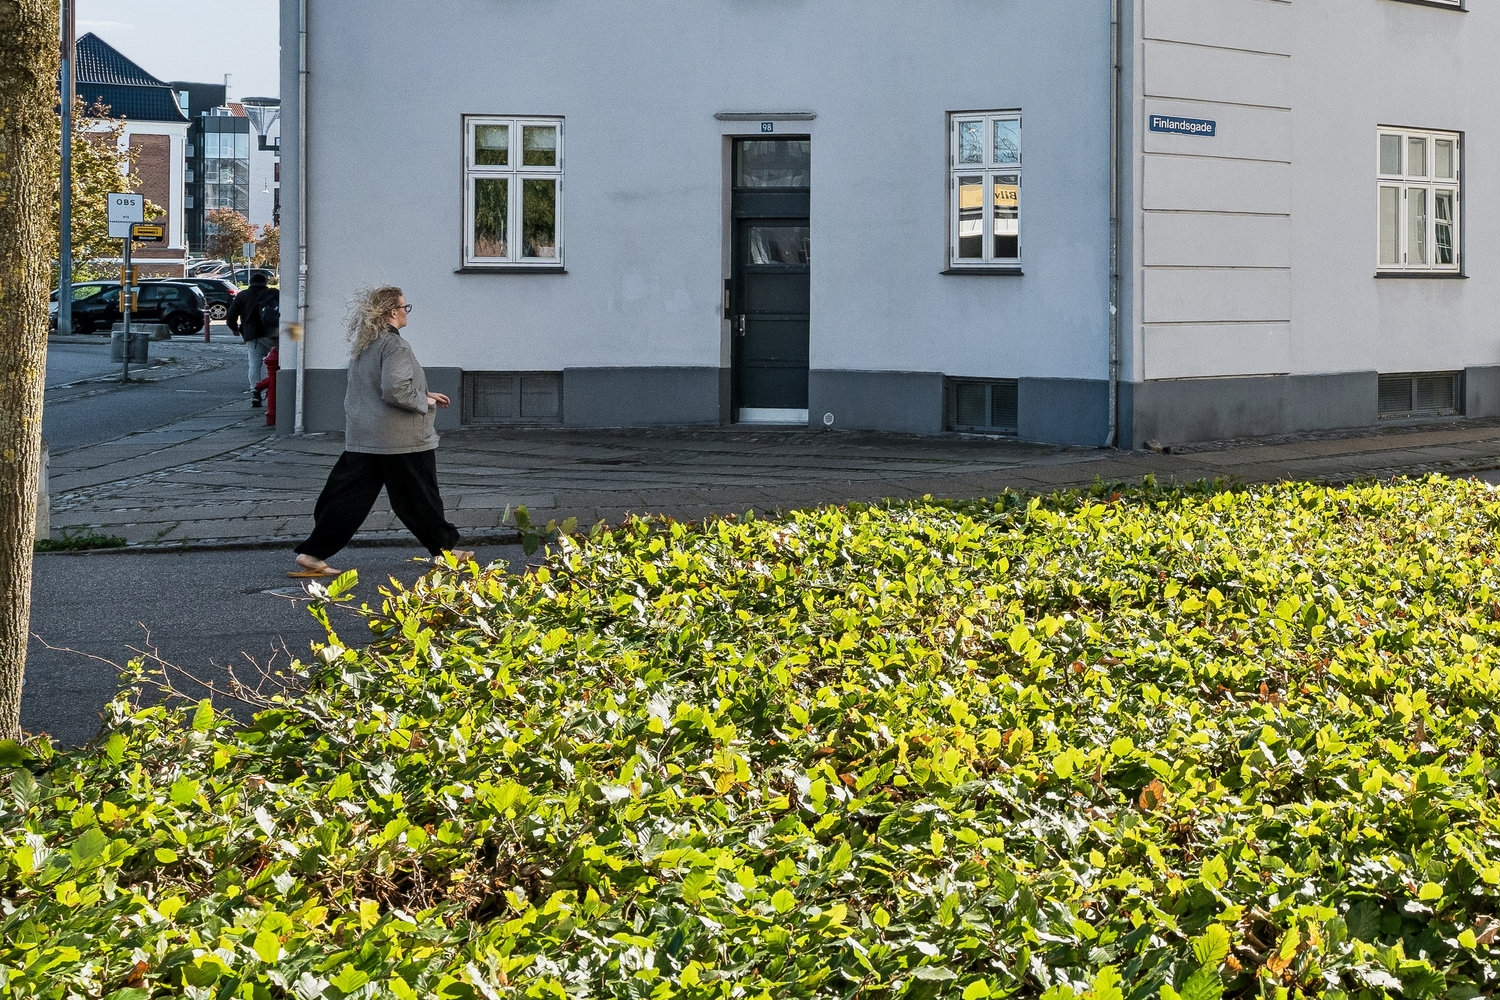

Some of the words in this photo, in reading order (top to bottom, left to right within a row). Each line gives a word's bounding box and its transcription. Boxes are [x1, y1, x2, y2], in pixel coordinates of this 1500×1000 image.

[762, 123, 772, 131] 98
[1153, 117, 1212, 133] Finlandsgade
[116, 198, 136, 206] OBS
